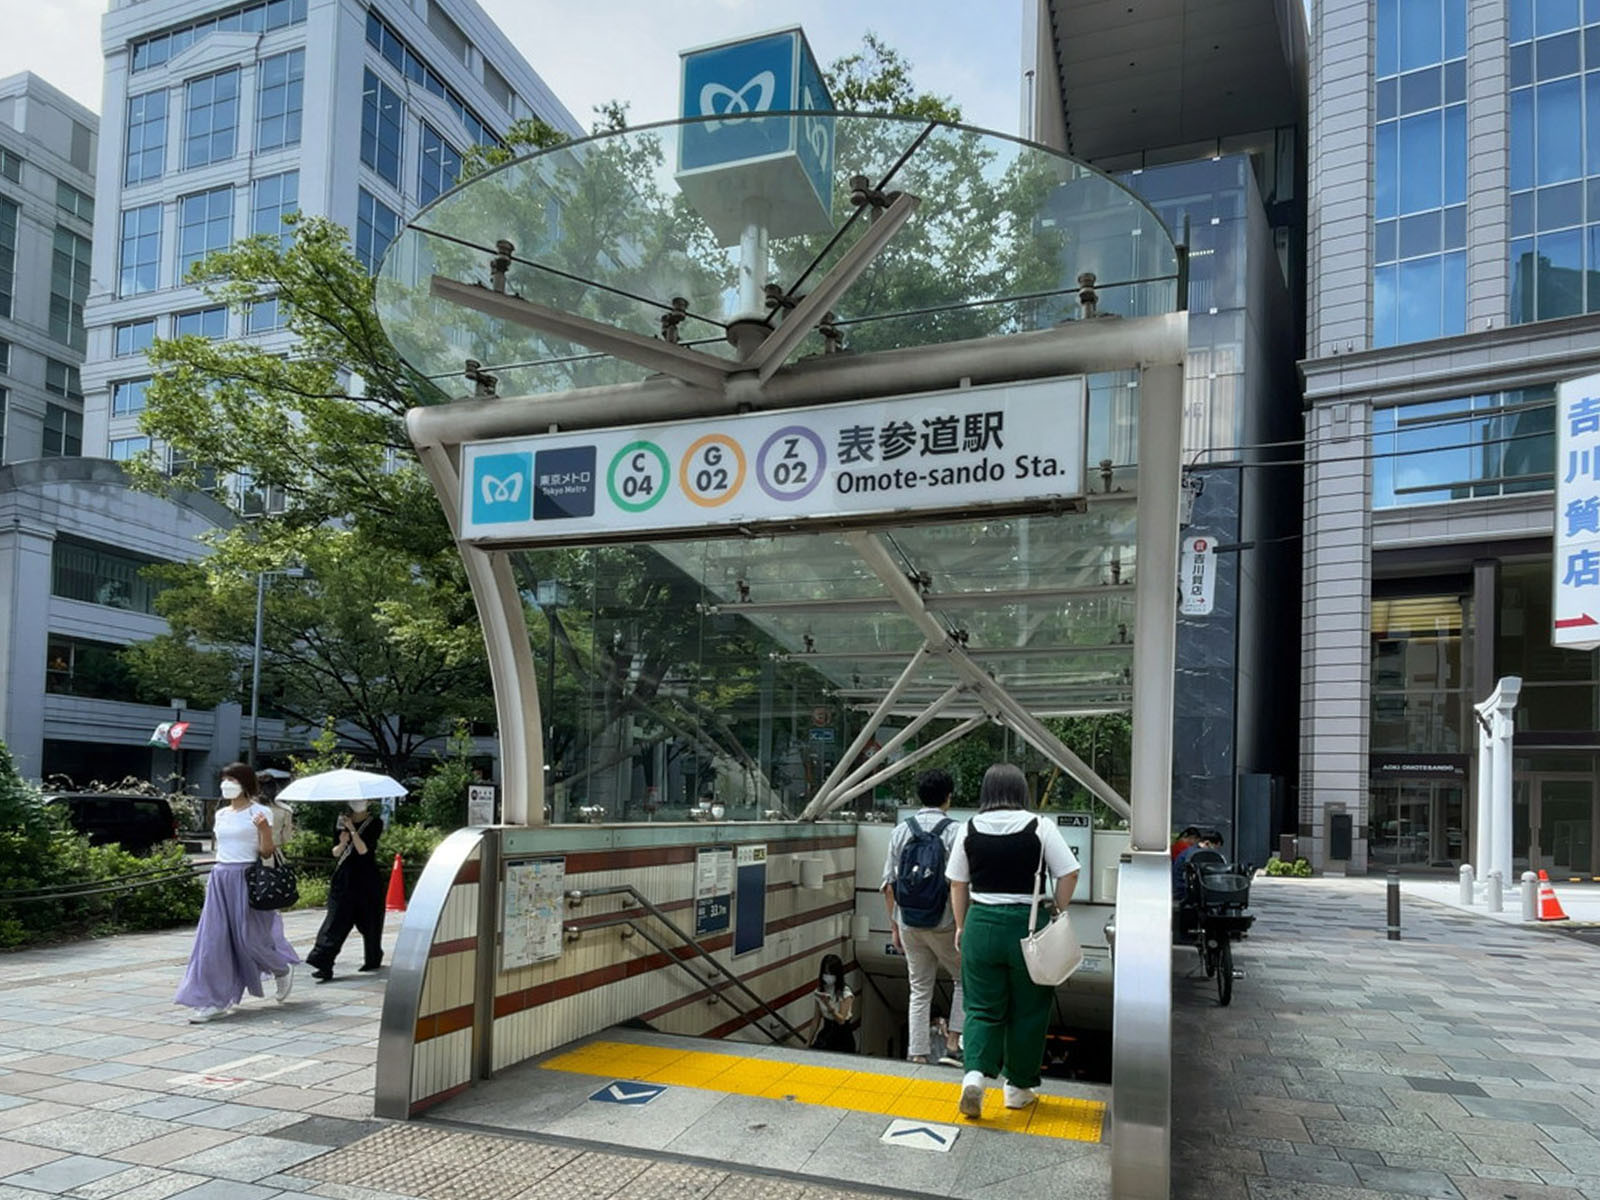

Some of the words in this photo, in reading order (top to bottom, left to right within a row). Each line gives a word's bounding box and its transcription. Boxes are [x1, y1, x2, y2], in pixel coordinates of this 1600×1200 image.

[783, 438, 800, 459] Z
[837, 411, 1004, 465] 表参道駅
[631, 453, 646, 472] C
[703, 446, 722, 466] G
[540, 472, 591, 486] 東京メトロ
[696, 469, 728, 492] 02
[774, 461, 808, 485] 02
[837, 457, 1005, 493] Omote-sando
[1015, 455, 1065, 479] Sta.
[542, 486, 564, 496] Tokyo
[565, 485, 588, 493] Metro
[622, 475, 653, 497] 04
[1562, 397, 1600, 588] 吉川質店
